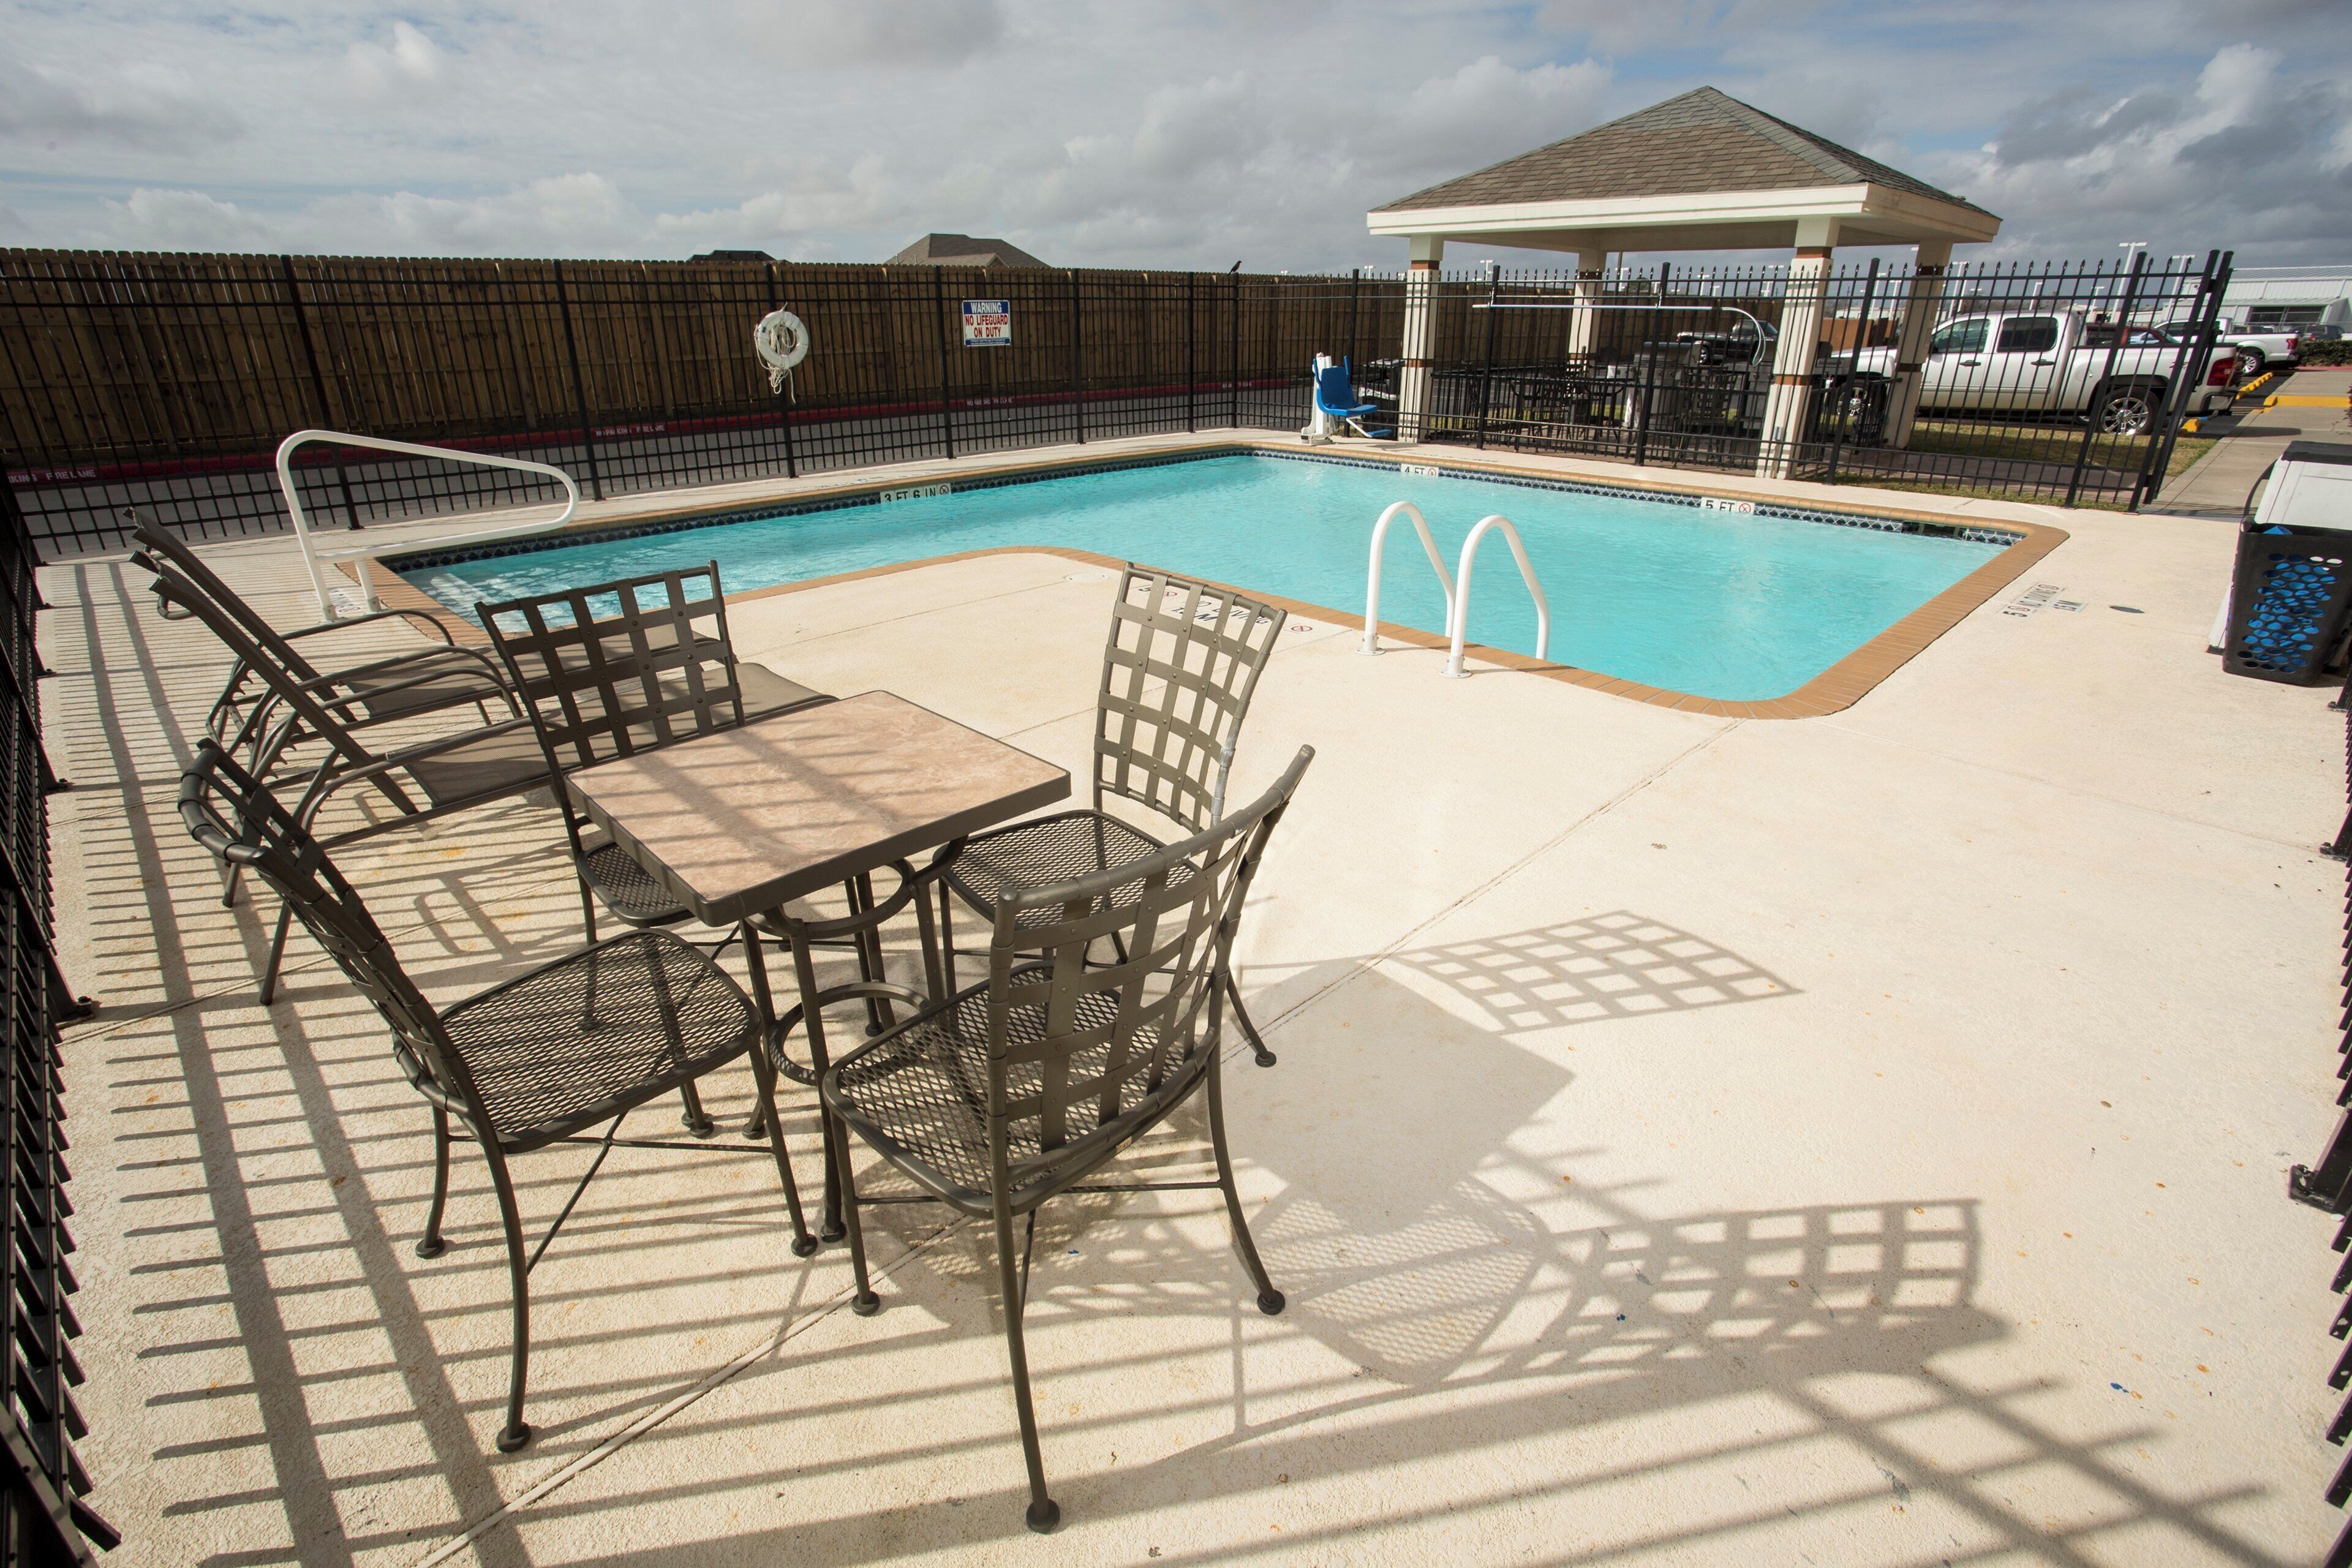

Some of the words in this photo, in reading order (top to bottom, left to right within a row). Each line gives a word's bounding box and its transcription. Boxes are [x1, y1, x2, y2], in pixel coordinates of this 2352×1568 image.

[971, 302, 1002, 314] WARNING
[965, 315, 974, 326] NO
[976, 314, 1008, 325] LIFEGUARD
[974, 326, 982, 337] ON
[986, 326, 1001, 337] DUTY
[1414, 467, 1425, 475] FT
[884, 493, 892, 502] 3
[896, 491, 908, 501] FT
[913, 489, 920, 499] 6
[925, 487, 936, 497] IN
[1705, 499, 1714, 509] 5
[1719, 501, 1735, 512] FT
